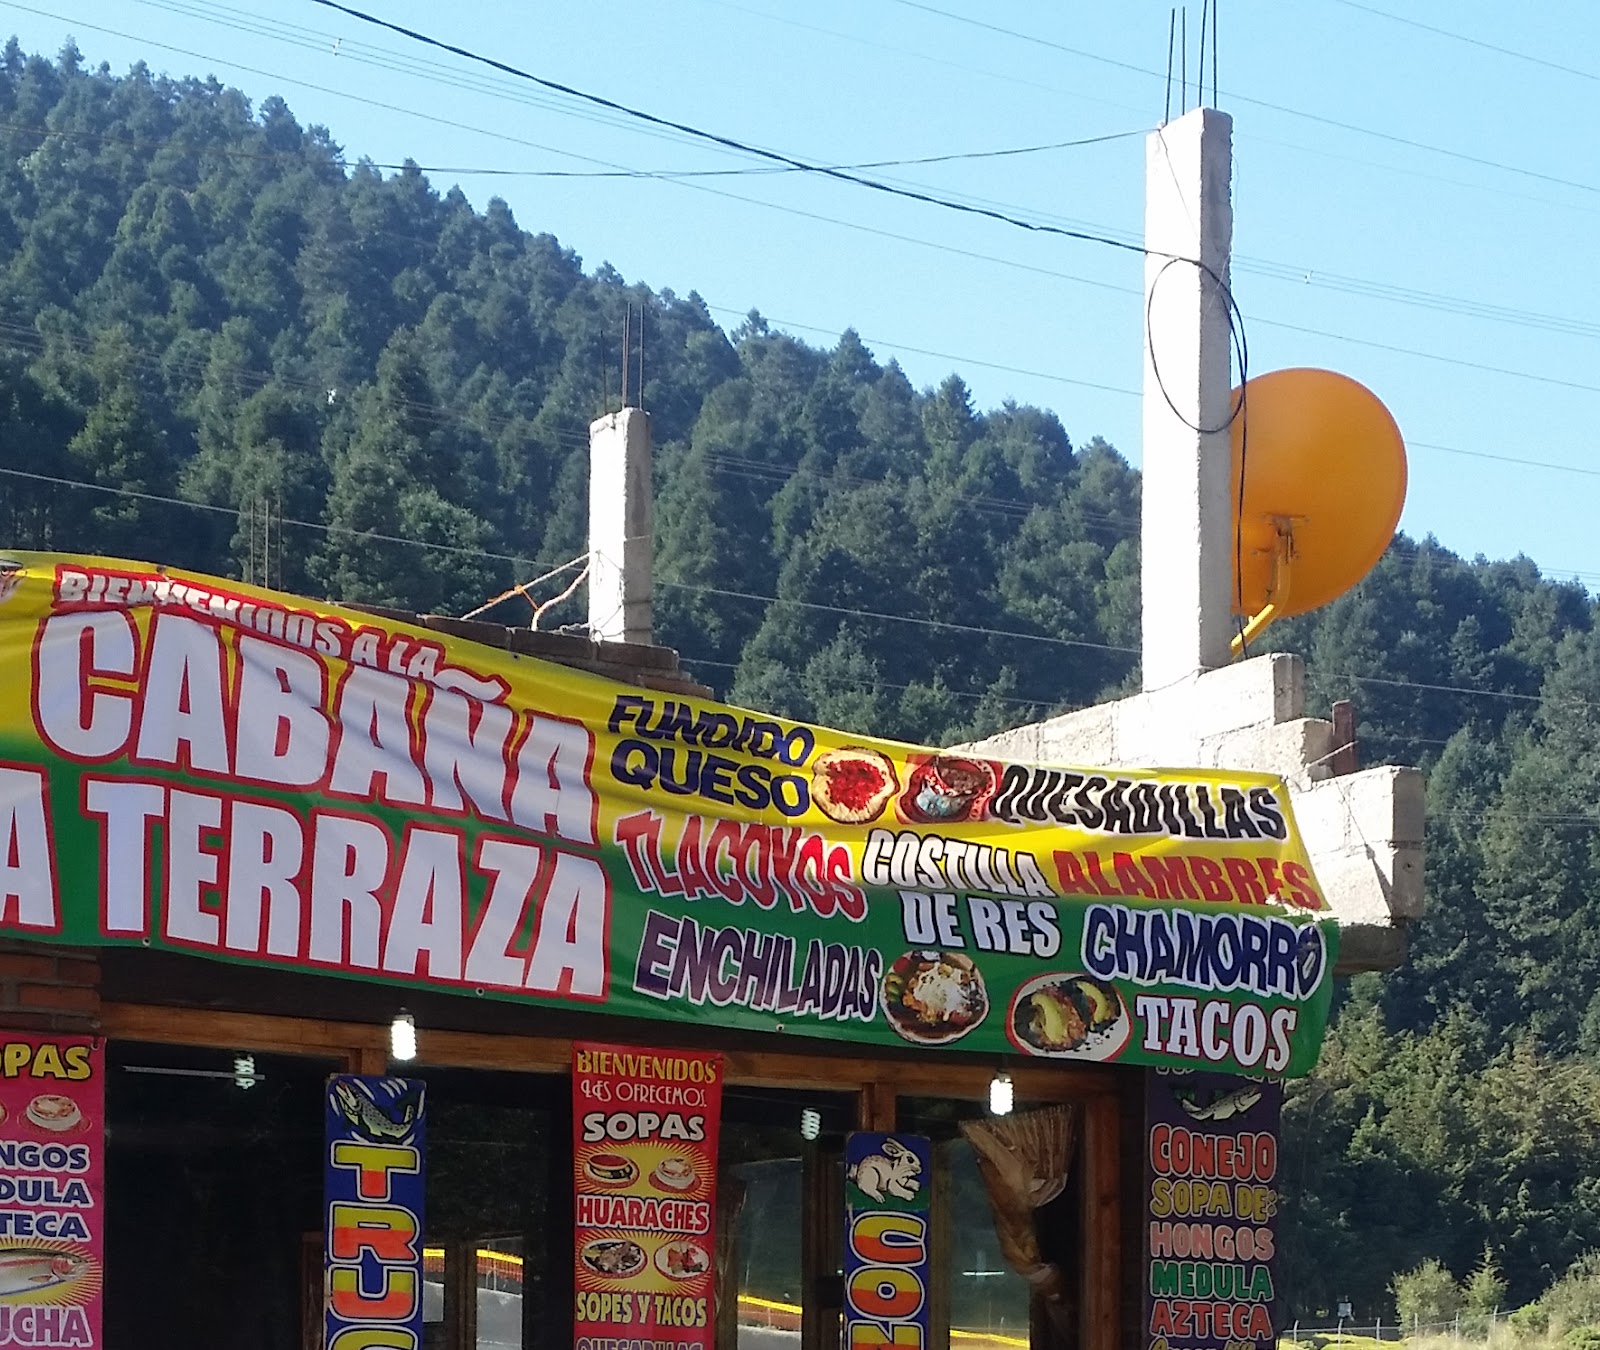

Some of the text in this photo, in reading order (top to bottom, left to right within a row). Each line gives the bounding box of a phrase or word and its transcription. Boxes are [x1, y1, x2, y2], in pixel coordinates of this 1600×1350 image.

[387, 638, 441, 681] LA
[33, 605, 599, 844] CABAÑA
[608, 694, 815, 767] FUNDIDO
[610, 738, 811, 817] QUESO
[990, 763, 1289, 841] QUESADILLAS
[81, 773, 611, 1001] TERRAZA
[613, 808, 868, 923] TLACOYOS
[862, 827, 1061, 898] COSTILLA
[1052, 849, 1323, 911] ALAMBRES
[899, 890, 1062, 959] DE RES
[1080, 903, 1328, 1001] CHAMORRO
[634, 909, 882, 1023] ENCHILADAS
[577, 1050, 716, 1084] BIENVENIDOS
[1136, 994, 1298, 1075] TACOS
[583, 1112, 705, 1142] SOPAS
[1150, 1123, 1277, 1183] CONEJO
[576, 1195, 709, 1234] HUARACHES
[1150, 1177, 1232, 1218] SOPA
[1150, 1221, 1275, 1261] HONGOS
[576, 1291, 707, 1327] SOPES Y TACOS
[1150, 1259, 1274, 1302] MEDULA
[1150, 1299, 1274, 1340] AZTECA
